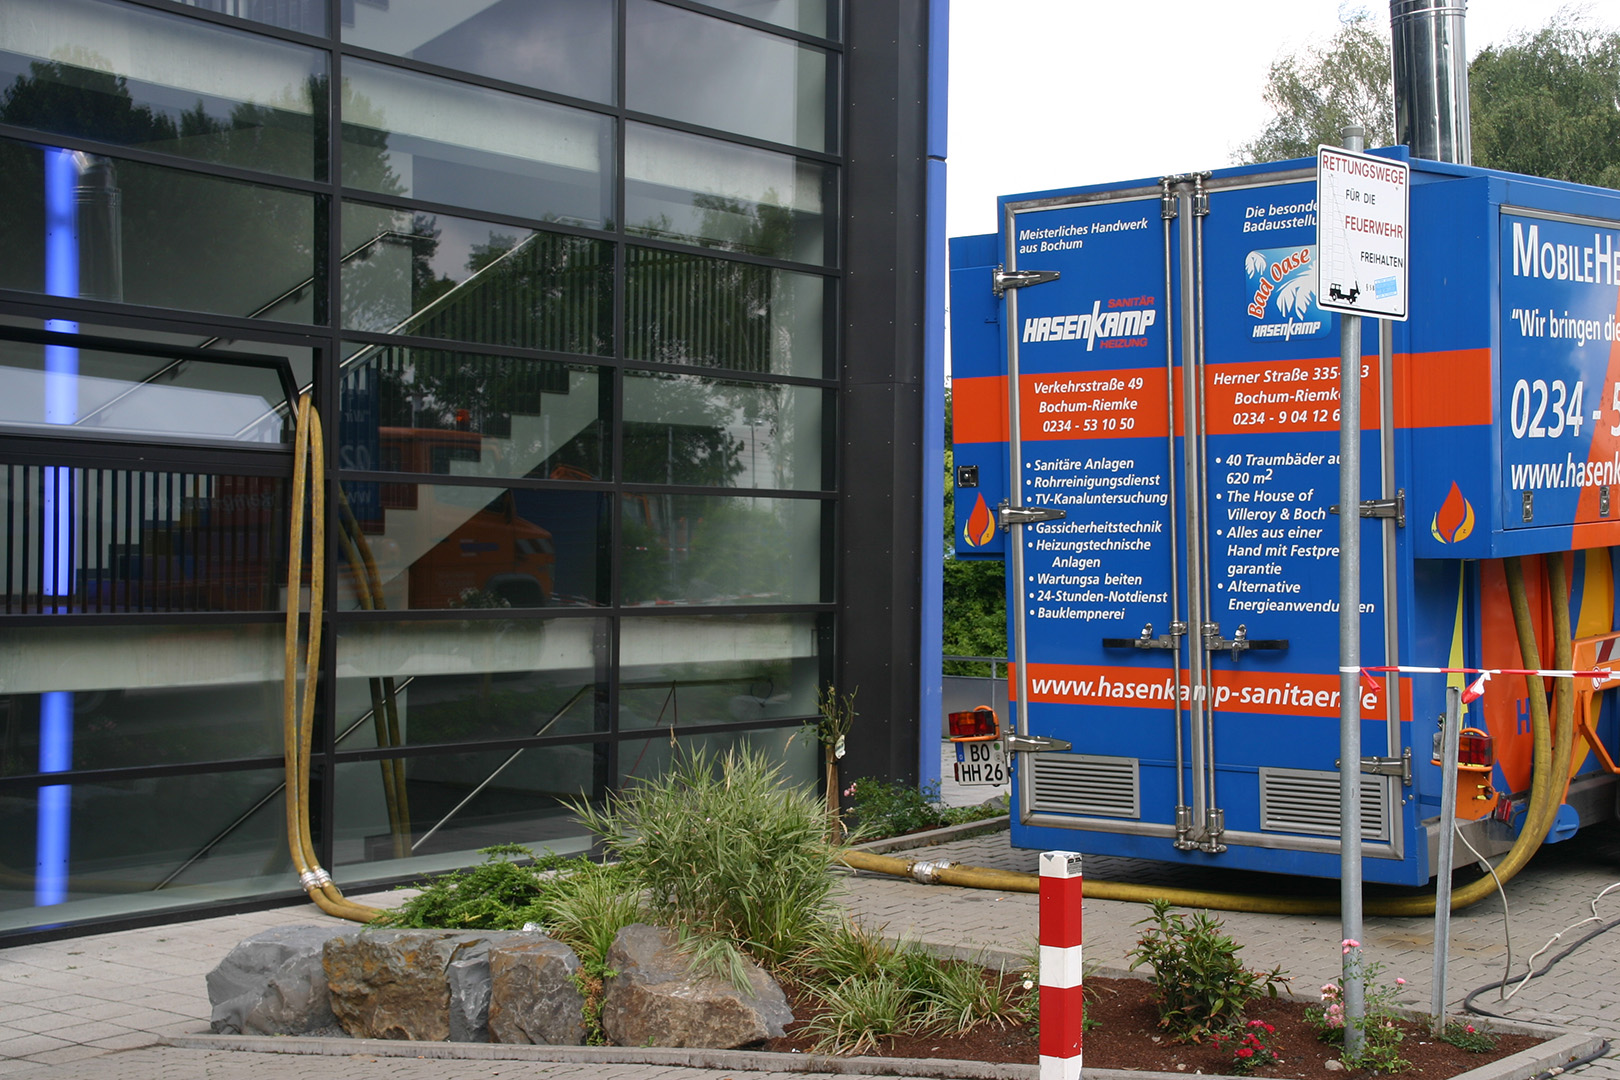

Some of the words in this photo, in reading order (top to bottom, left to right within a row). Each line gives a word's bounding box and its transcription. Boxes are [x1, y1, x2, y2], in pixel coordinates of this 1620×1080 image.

[1323, 155, 1404, 185] RETTUNGSWEGE
[1346, 188, 1360, 202] FÜR
[1364, 193, 1375, 205] DIE
[1245, 206, 1264, 218] Die
[1268, 200, 1317, 215] besonde
[1020, 225, 1088, 240] Meisterliches
[1091, 218, 1148, 234] Handwerk
[1243, 214, 1317, 232] Badausstellu
[1345, 216, 1403, 239] FEUERWEHR
[1020, 244, 1037, 253] aus
[1040, 239, 1083, 252] Bochum
[1361, 251, 1403, 268] FREIHALTEN
[1248, 277, 1274, 319] Bad
[1270, 248, 1310, 282] Oase
[1108, 296, 1155, 308] SANITÄR
[1550, 309, 1600, 346] bringen
[1100, 338, 1148, 348] HEIZUNG
[1214, 373, 1260, 385] Herner
[1264, 368, 1308, 383] Straße
[1034, 378, 1124, 394] Verkehrsstraße
[1128, 378, 1143, 389] 49
[1234, 387, 1341, 404] Bochum-Riemk
[1039, 398, 1138, 413] Bochum-Riemke
[1510, 379, 1583, 438] 0234
[1233, 412, 1265, 425] 0234
[1279, 411, 1287, 423] 9
[1291, 410, 1307, 423] 04
[1312, 410, 1328, 422] 12
[1332, 409, 1340, 421] 6
[1043, 420, 1071, 432] 0234
[1083, 419, 1097, 431] 53
[1102, 419, 1116, 430] 10
[1120, 418, 1134, 429] 50
[1034, 459, 1081, 471] Sanitäre
[1084, 458, 1134, 472] Anlagen
[1226, 454, 1242, 466] 40
[1246, 452, 1324, 466] Traumbäder
[1328, 455, 1340, 465] au
[1034, 474, 1160, 489] Rohrreinigungsdienst
[1226, 472, 1249, 484] 620
[1035, 491, 1168, 506] TV-Kanaluntersuchung
[1227, 490, 1250, 502] The
[1254, 490, 1294, 502] House
[1298, 489, 1314, 501] of
[1228, 508, 1276, 523] Villeroy
[1280, 508, 1290, 520] &
[1294, 506, 1326, 520] Boch
[1036, 521, 1162, 534] Gassicherheitstechnik
[1226, 526, 1258, 538] Alles
[1262, 529, 1284, 539] aus
[1288, 527, 1322, 539] einer
[1036, 538, 1151, 553] Heizungstechnische
[1227, 544, 1262, 556] Hand
[1265, 545, 1287, 557] mit
[1290, 545, 1340, 559] Festpre
[1052, 556, 1100, 570] Anlagen
[1227, 563, 1282, 577] garantie
[1228, 580, 1300, 593] Alternative
[1037, 590, 1167, 603] 24-Stunden-Notdienst
[1228, 598, 1375, 614] Energieanwenduen
[1038, 607, 1125, 622] Bauklempnerei
[1032, 676, 1377, 710] www.hasenkamp-sanitaer.e
[970, 744, 990, 762] BO
[962, 764, 981, 781] HH
[984, 764, 1003, 781] 26
